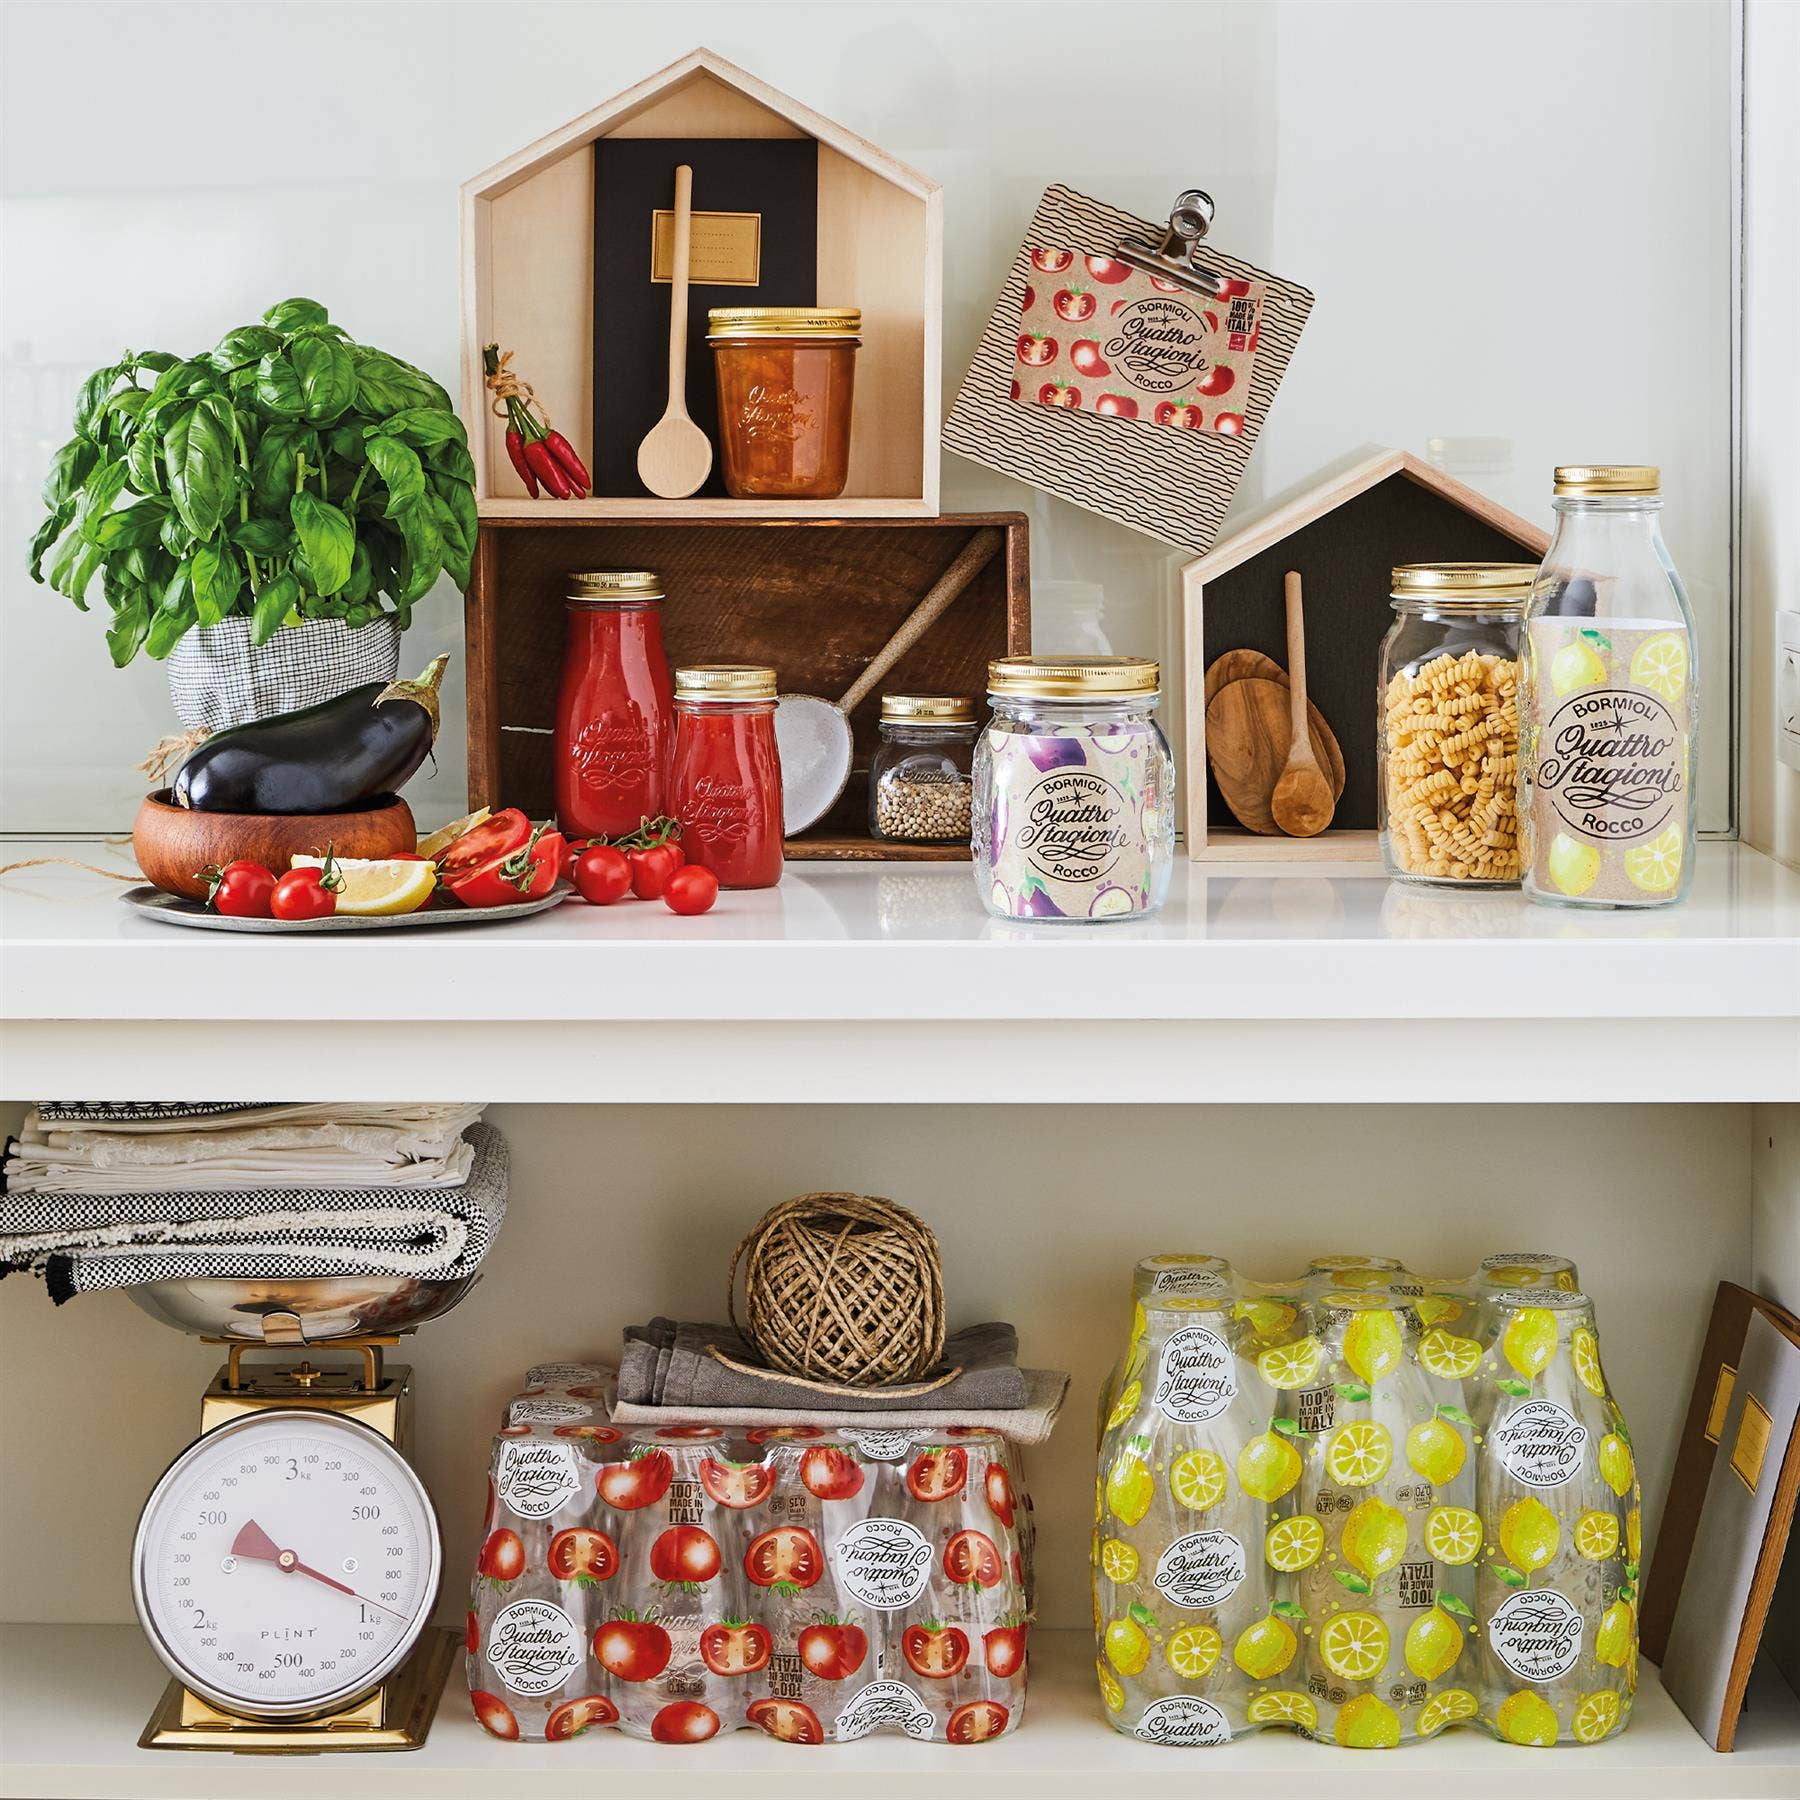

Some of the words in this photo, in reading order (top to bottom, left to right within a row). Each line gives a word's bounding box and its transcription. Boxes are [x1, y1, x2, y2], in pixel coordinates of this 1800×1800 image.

[1138, 303, 1192, 322] BORMIOLI
[1122, 317, 1203, 345] Quattro
[1227, 319, 1253, 332] ITALY
[1134, 373, 1173, 389] ROCCO
[1572, 697, 1658, 721] BORMIOLI
[1555, 724, 1674, 760] Quattro
[1042, 778, 1107, 796] BORMIOLI
[1030, 799, 1120, 826] Quattro
[1582, 813, 1644, 833] ROCCO
[1053, 863, 1099, 878] ROCCO
[1172, 1332, 1217, 1347] BORMIOLI
[1166, 1349, 1226, 1377] Quattro
[1299, 1389, 1334, 1407] 100%
[1177, 1408, 1209, 1419] ROCCO
[1299, 1406, 1323, 1416] MADE
[1325, 1403, 1334, 1413] IN
[1524, 1404, 1557, 1416] ROCCO
[1299, 1412, 1334, 1430] ITALY
[264, 1456, 279, 1464] 900
[304, 1455, 319, 1463] 100
[505, 1447, 566, 1472] Quattro
[1506, 1442, 1576, 1465] Quattro
[241, 1465, 257, 1473] 800
[285, 1458, 298, 1481] 3
[301, 1470, 312, 1481] kg
[325, 1461, 341, 1470] 200
[343, 1472, 359, 1481] 300
[1517, 1466, 1567, 1482] BORMIOLI
[222, 1478, 237, 1486] 700
[203, 1492, 219, 1500] 600
[360, 1487, 376, 1495] 400
[670, 1484, 703, 1498] 100%
[520, 1499, 550, 1512] ROCCO
[670, 1498, 693, 1508] MADE
[694, 1499, 703, 1508] IN
[199, 1511, 226, 1525] 500
[352, 1505, 380, 1520] 500
[669, 1508, 704, 1522] ITALY
[181, 1532, 196, 1540] 400
[382, 1526, 398, 1535] 600
[866, 1523, 902, 1536] ROCCO
[1178, 1536, 1224, 1552] BORMIOLI
[175, 1554, 190, 1563] 300
[387, 1547, 403, 1556] 700
[1167, 1550, 1235, 1573] Quattro
[386, 1570, 401, 1579] 800
[847, 1566, 919, 1588] Quattro
[1400, 1565, 1433, 1580] ITALY
[174, 1578, 190, 1586] 200
[1400, 1581, 1408, 1590] IN
[1411, 1580, 1433, 1590] MADE
[380, 1592, 397, 1601] 900
[858, 1587, 911, 1604] BORMIOLI
[1182, 1595, 1215, 1604] ROCCO
[1400, 1590, 1433, 1604] 100%
[1520, 1594, 1555, 1605] ROCCO
[179, 1599, 193, 1608] 100
[192, 1609, 206, 1630] 2
[206, 1618, 218, 1631] kg
[359, 1604, 366, 1624] 1
[369, 1613, 381, 1626] kg
[508, 1606, 558, 1622] BORMIOLI
[359, 1632, 374, 1640] 100
[499, 1622, 569, 1646] Quattro
[201, 1638, 216, 1646] 900
[1501, 1636, 1572, 1659] Quattro
[218, 1652, 234, 1661] 800
[274, 1653, 302, 1668] 500
[340, 1649, 356, 1658] 200
[237, 1663, 254, 1672] 700
[320, 1661, 336, 1670] 300
[768, 1657, 803, 1672] ITALY
[1513, 1658, 1562, 1676] BORMIOLI
[258, 1669, 275, 1680] 600
[298, 1668, 315, 1678] 400
[514, 1676, 549, 1690] ROCCO
[769, 1681, 803, 1697] 100%
[865, 1684, 904, 1697] ROCCO
[1160, 1702, 1207, 1715] BORMIOLI
[1148, 1717, 1219, 1736] Quattro
